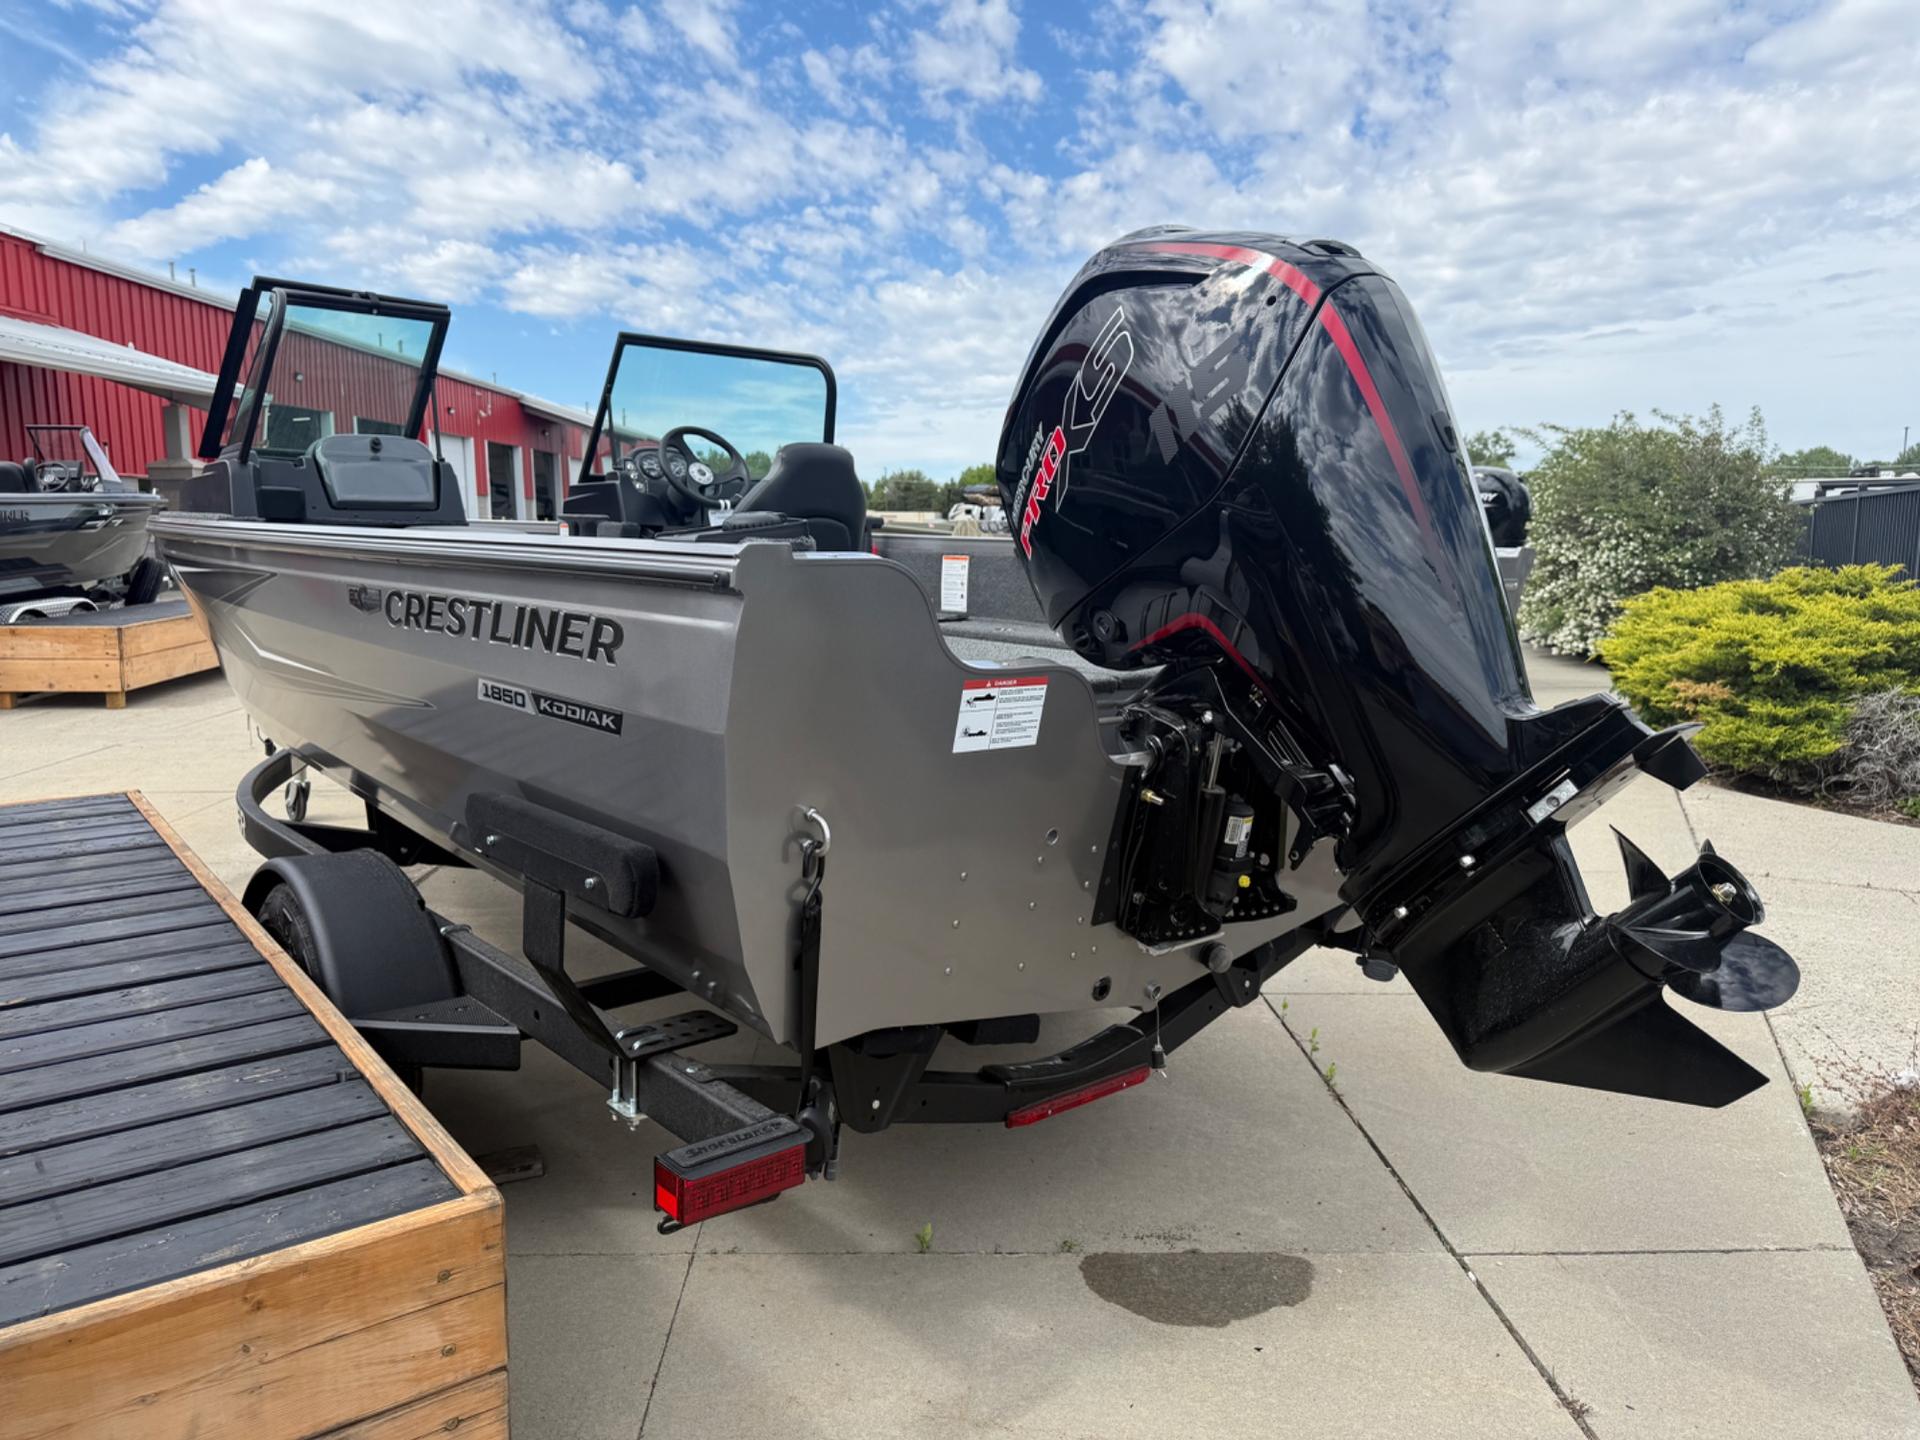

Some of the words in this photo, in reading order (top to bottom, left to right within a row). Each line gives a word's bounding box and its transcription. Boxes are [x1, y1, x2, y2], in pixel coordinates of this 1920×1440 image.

[1020, 425, 1066, 560] PRO
[1056, 305, 1134, 514] XS
[384, 590, 625, 666] CRESTLINER
[482, 682, 526, 708] 1850
[539, 699, 617, 729] KODIAK
